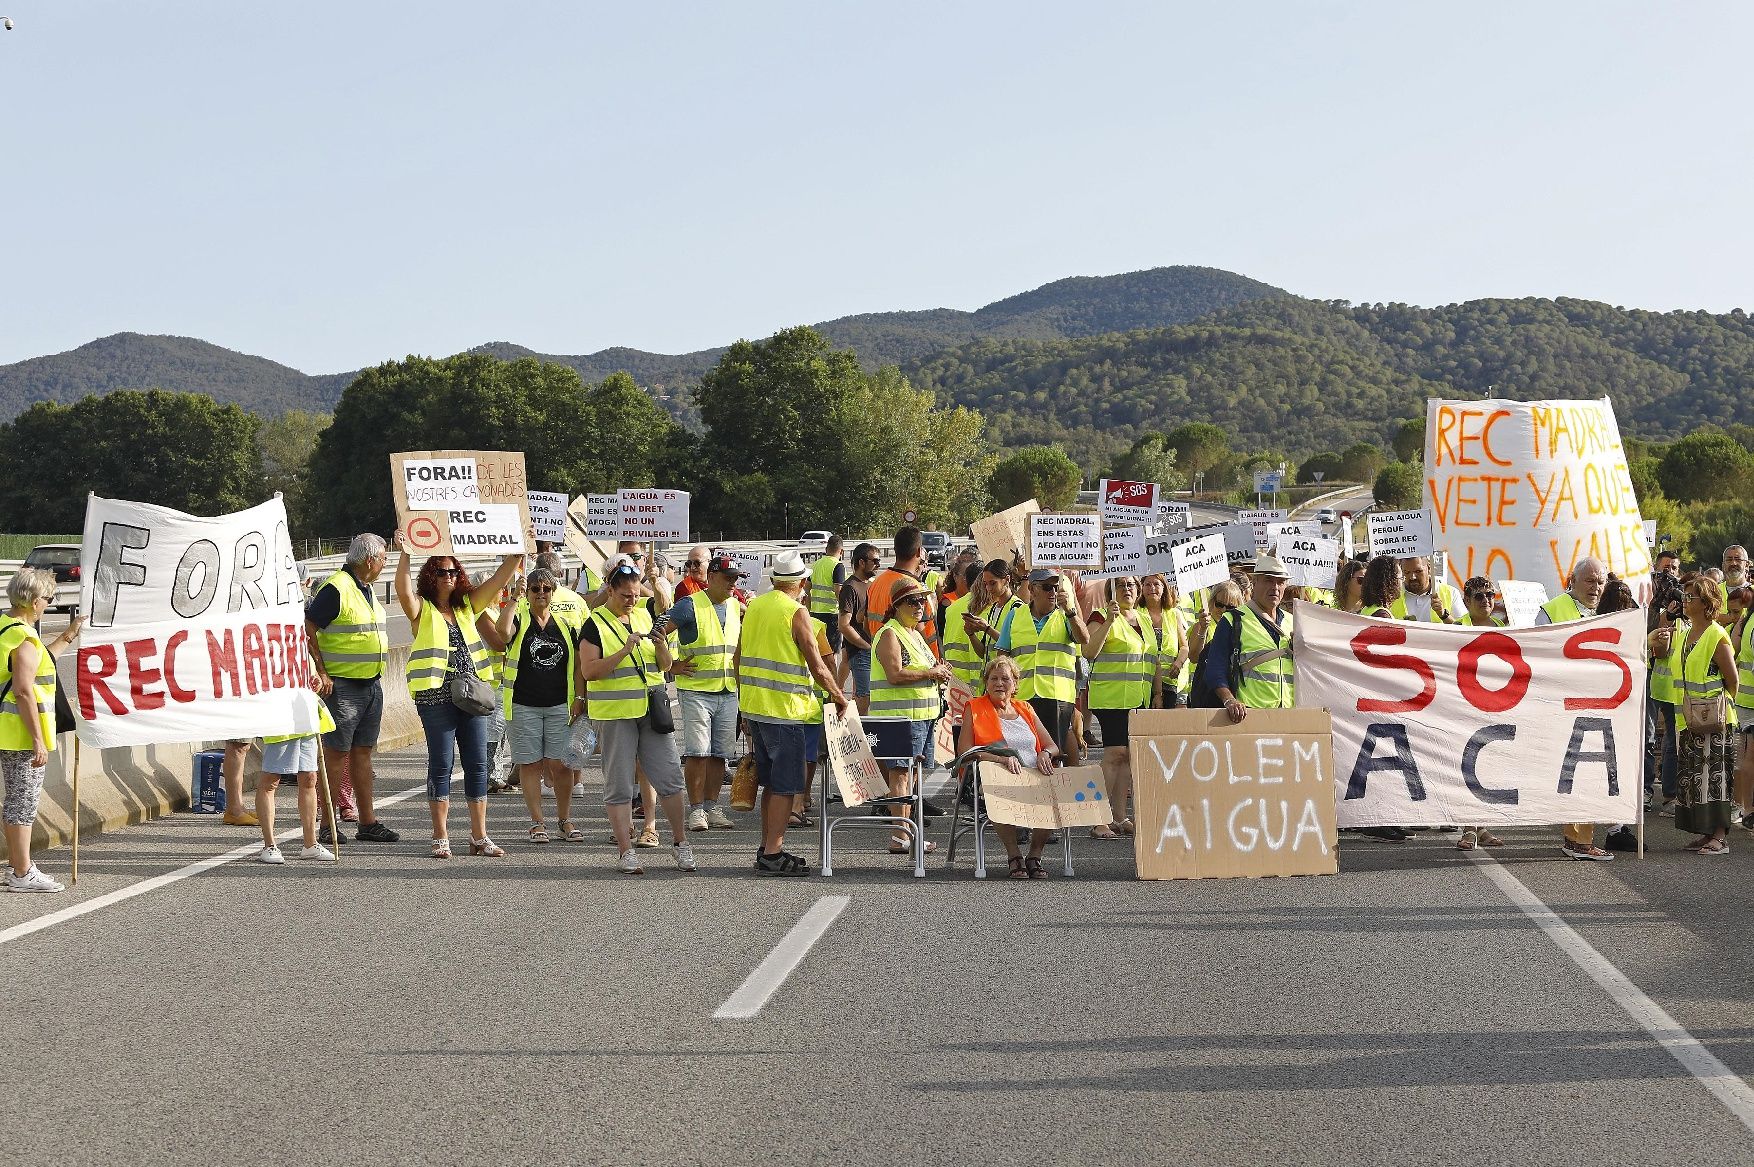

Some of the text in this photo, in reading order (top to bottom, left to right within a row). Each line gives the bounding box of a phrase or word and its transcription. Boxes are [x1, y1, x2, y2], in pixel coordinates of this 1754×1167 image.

[1435, 405, 1512, 467] REC
[406, 463, 522, 481] FORA!! DE LES
[408, 486, 458, 501] NOSTRES
[622, 492, 658, 500] L'AIGUA
[1129, 484, 1148, 497] SOS
[1428, 462, 1638, 533] VETE YA QUE
[638, 505, 665, 513] DRET,
[450, 511, 487, 523] REC
[624, 517, 655, 525] NO UN
[1057, 518, 1095, 526] MADRAL,
[1371, 515, 1394, 523] FALTA
[1281, 526, 1302, 535] ACA
[453, 534, 519, 545] MADRAL
[1292, 541, 1317, 551] ACA
[1374, 537, 1399, 545] SOBRA
[1186, 543, 1206, 557] ACA
[1375, 548, 1406, 556] MADRAL
[1179, 561, 1204, 574] ACTUA
[1282, 556, 1310, 566] ACTUA
[91, 521, 303, 627] FORA
[78, 629, 197, 720] REC
[1350, 626, 1633, 713] SOS
[1148, 738, 1323, 785] VOLEM
[1344, 717, 1620, 805] ACA
[1155, 798, 1328, 856] AIGUA
